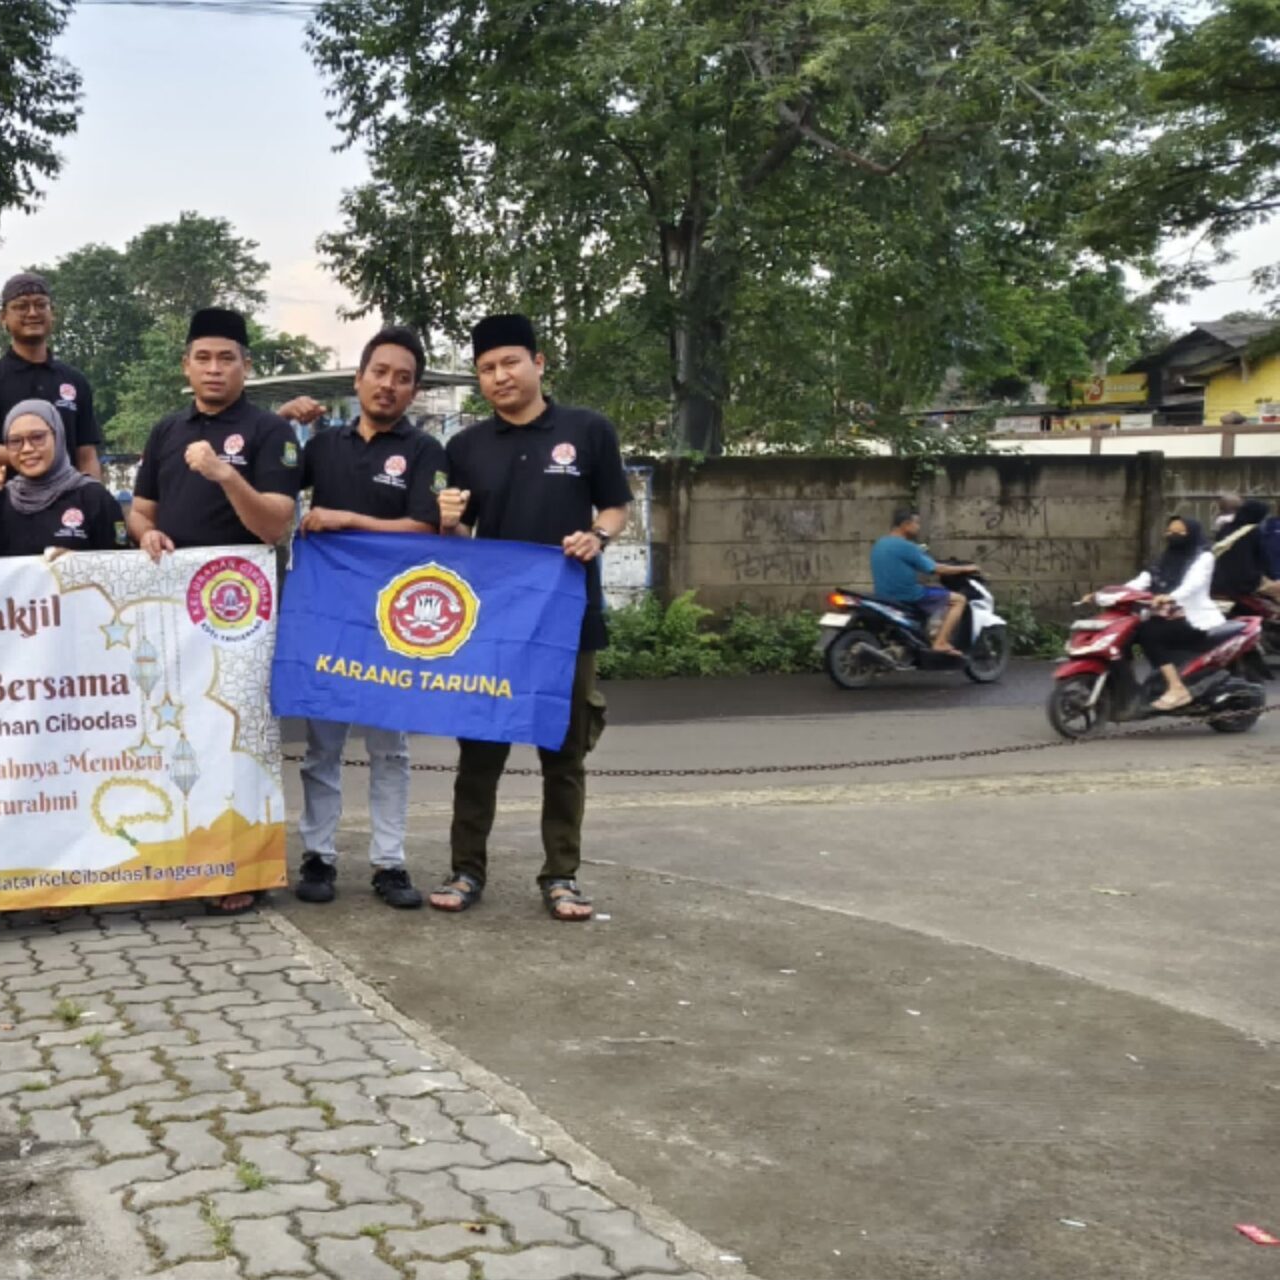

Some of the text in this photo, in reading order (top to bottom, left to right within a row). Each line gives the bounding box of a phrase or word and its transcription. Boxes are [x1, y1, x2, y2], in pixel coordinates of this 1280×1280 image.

[315, 653, 513, 699] KARANG TARUNA
[45, 711, 138, 733] Cibodas
